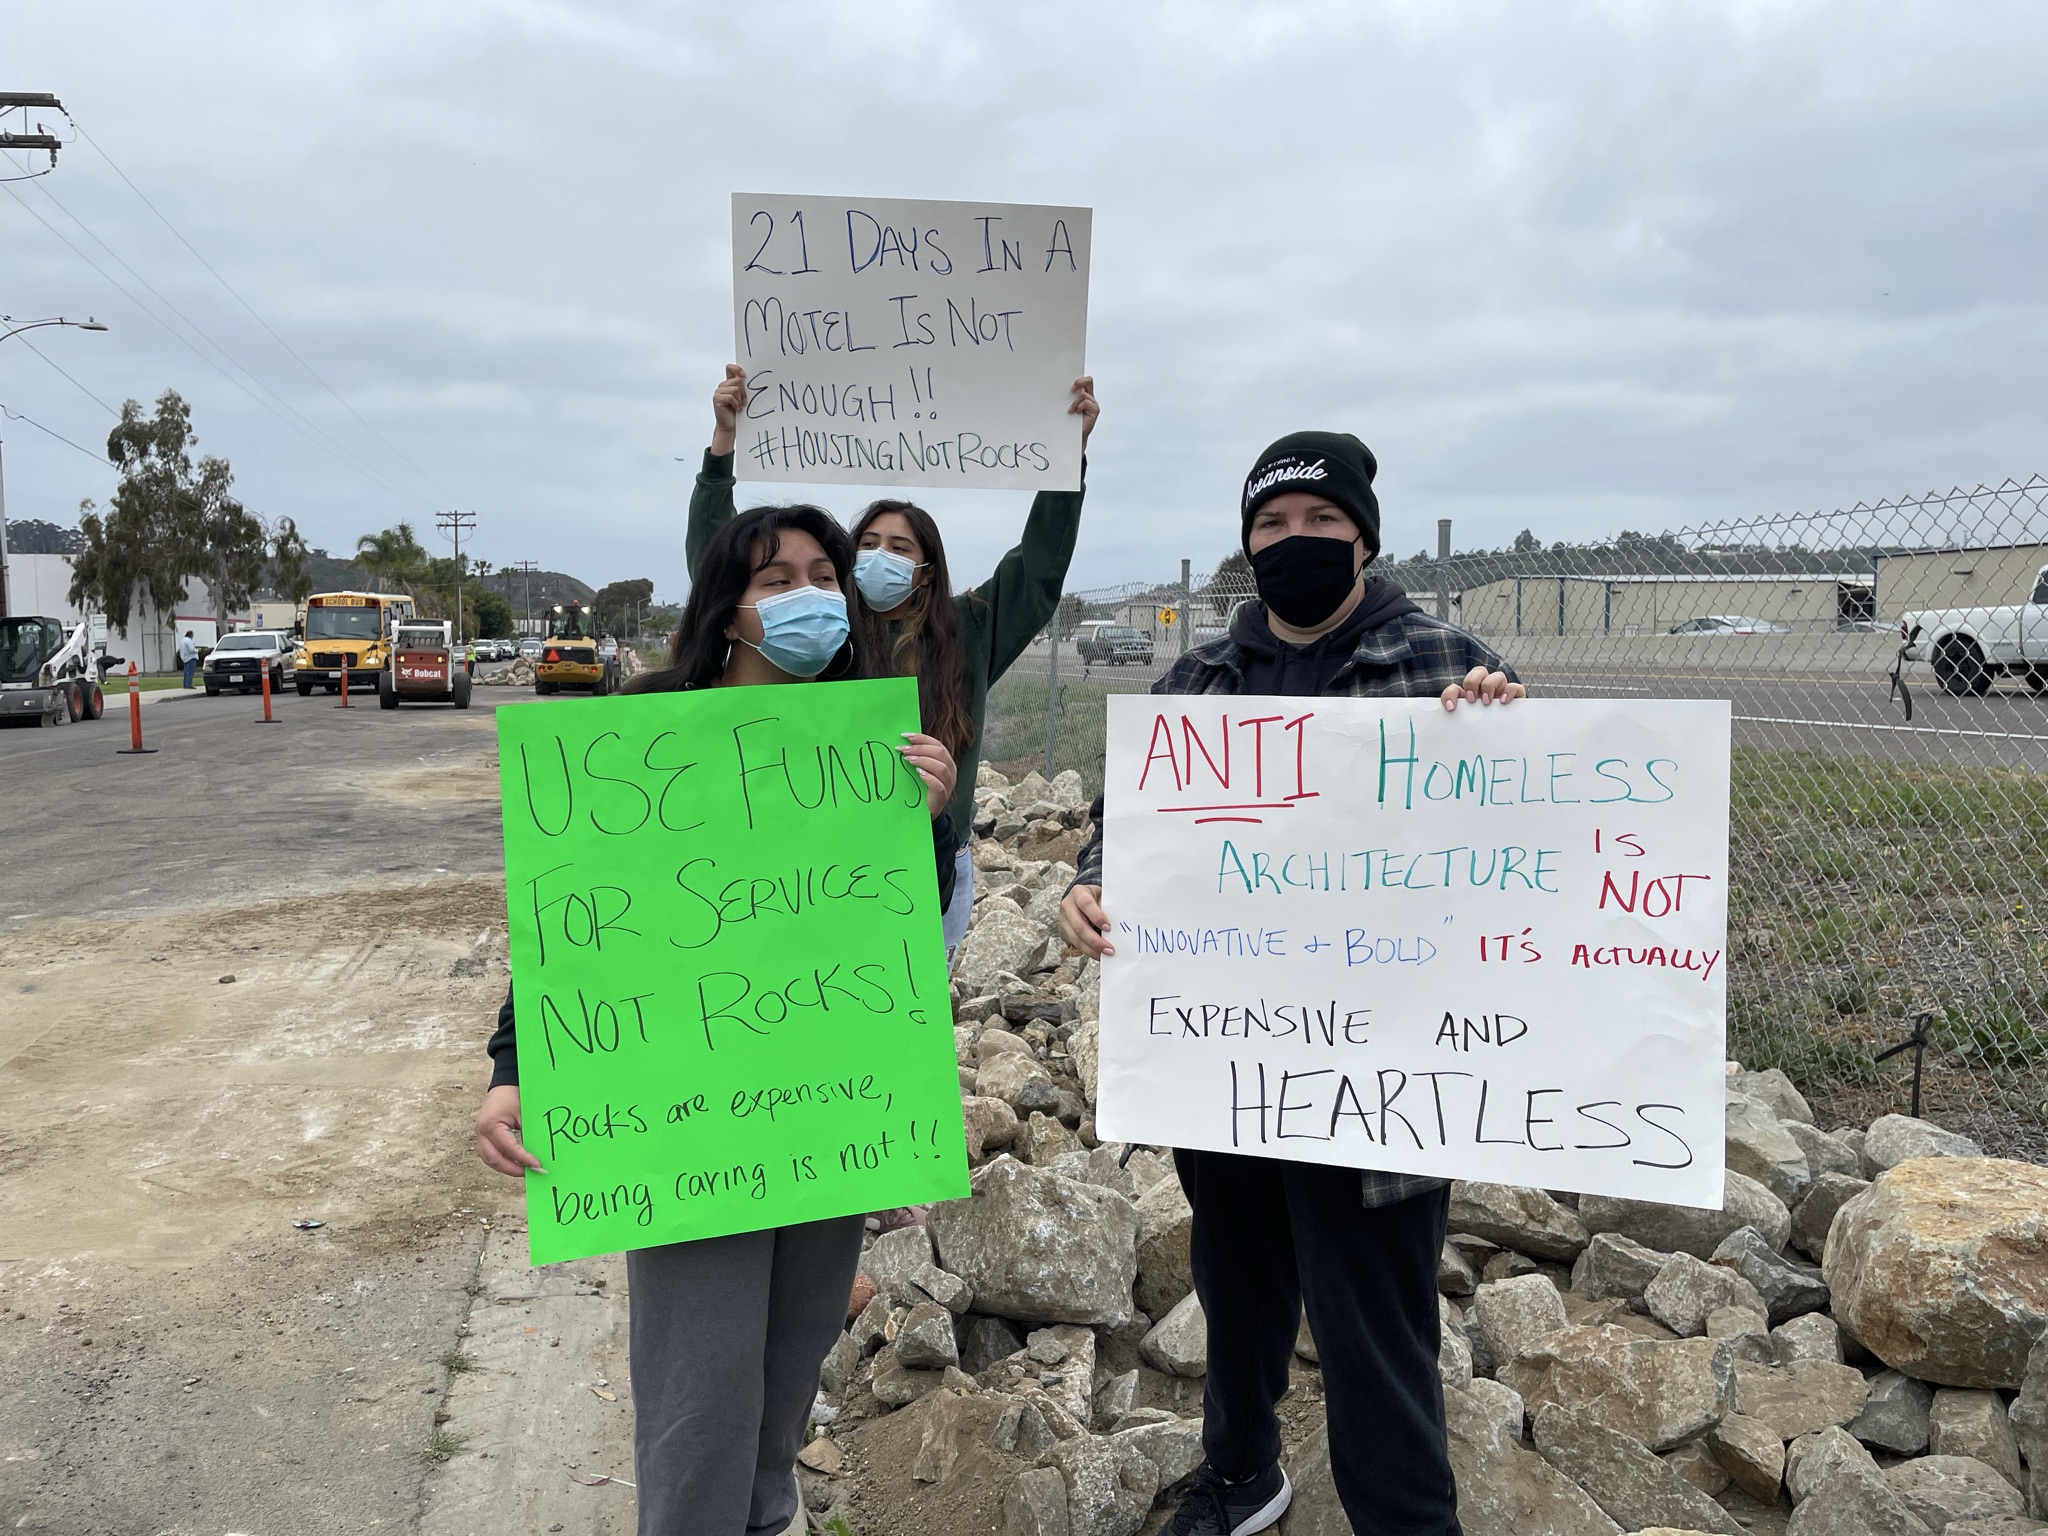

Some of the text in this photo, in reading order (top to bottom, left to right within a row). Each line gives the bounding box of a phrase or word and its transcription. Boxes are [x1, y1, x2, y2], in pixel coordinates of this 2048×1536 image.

[743, 209, 1077, 276] 21 DAYS IN A
[744, 294, 1023, 358] MOTEL IS NOT
[748, 425, 1050, 474] #HOUSINGNOTROCKS
[414, 669, 442, 678] Bobcat
[520, 717, 922, 837] USE FUNDS
[1138, 712, 1678, 811] ANTI HOMELESS
[1217, 839, 1562, 895] ARCHITECTURE
[1595, 828, 1646, 857] IS
[528, 858, 914, 967] FOR SERVICES
[1598, 870, 1712, 918] NOT
[1480, 926, 1542, 964] IT'S
[1571, 943, 1721, 982] ACTUALLY
[540, 938, 927, 1071] NOT ROCKS!
[1149, 995, 1529, 1053] EXPENSIVE AND
[666, 1093, 709, 1124] are
[730, 1074, 892, 1122] expensive,
[1230, 1060, 1694, 1168] HEARTLESS
[551, 1183, 653, 1227] being
[675, 1163, 766, 1201] caring
[792, 1155, 818, 1183] is
